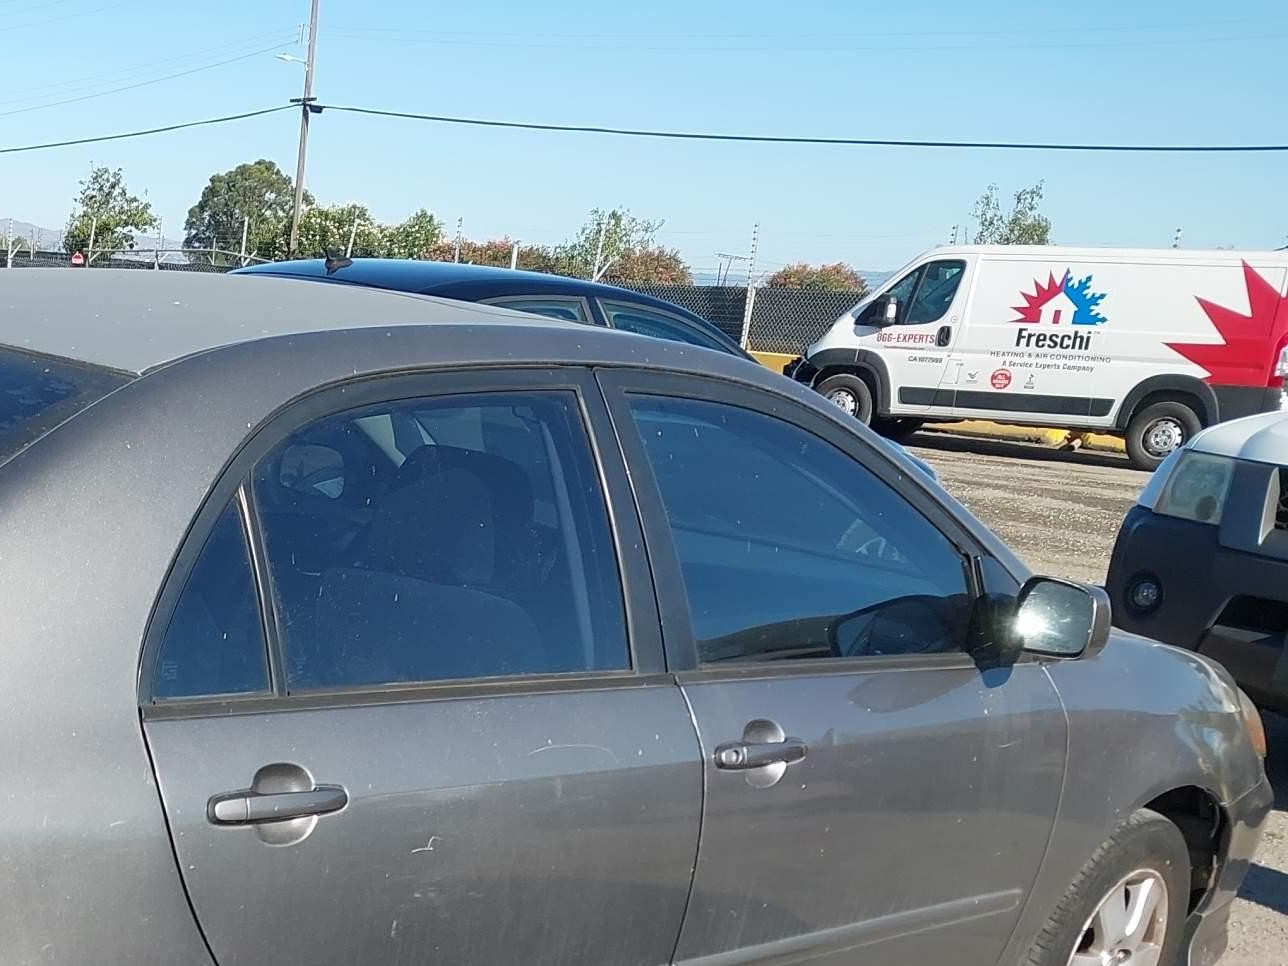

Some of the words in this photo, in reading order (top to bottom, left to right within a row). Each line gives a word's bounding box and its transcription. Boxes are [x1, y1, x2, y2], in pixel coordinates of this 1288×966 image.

[1015, 328, 1092, 350] Freschi
[990, 351, 1025, 359] HEATING
[1050, 354, 1112, 363] CONDITIONING
[1035, 362, 1061, 370] Experts
[1062, 363, 1094, 373] Company
